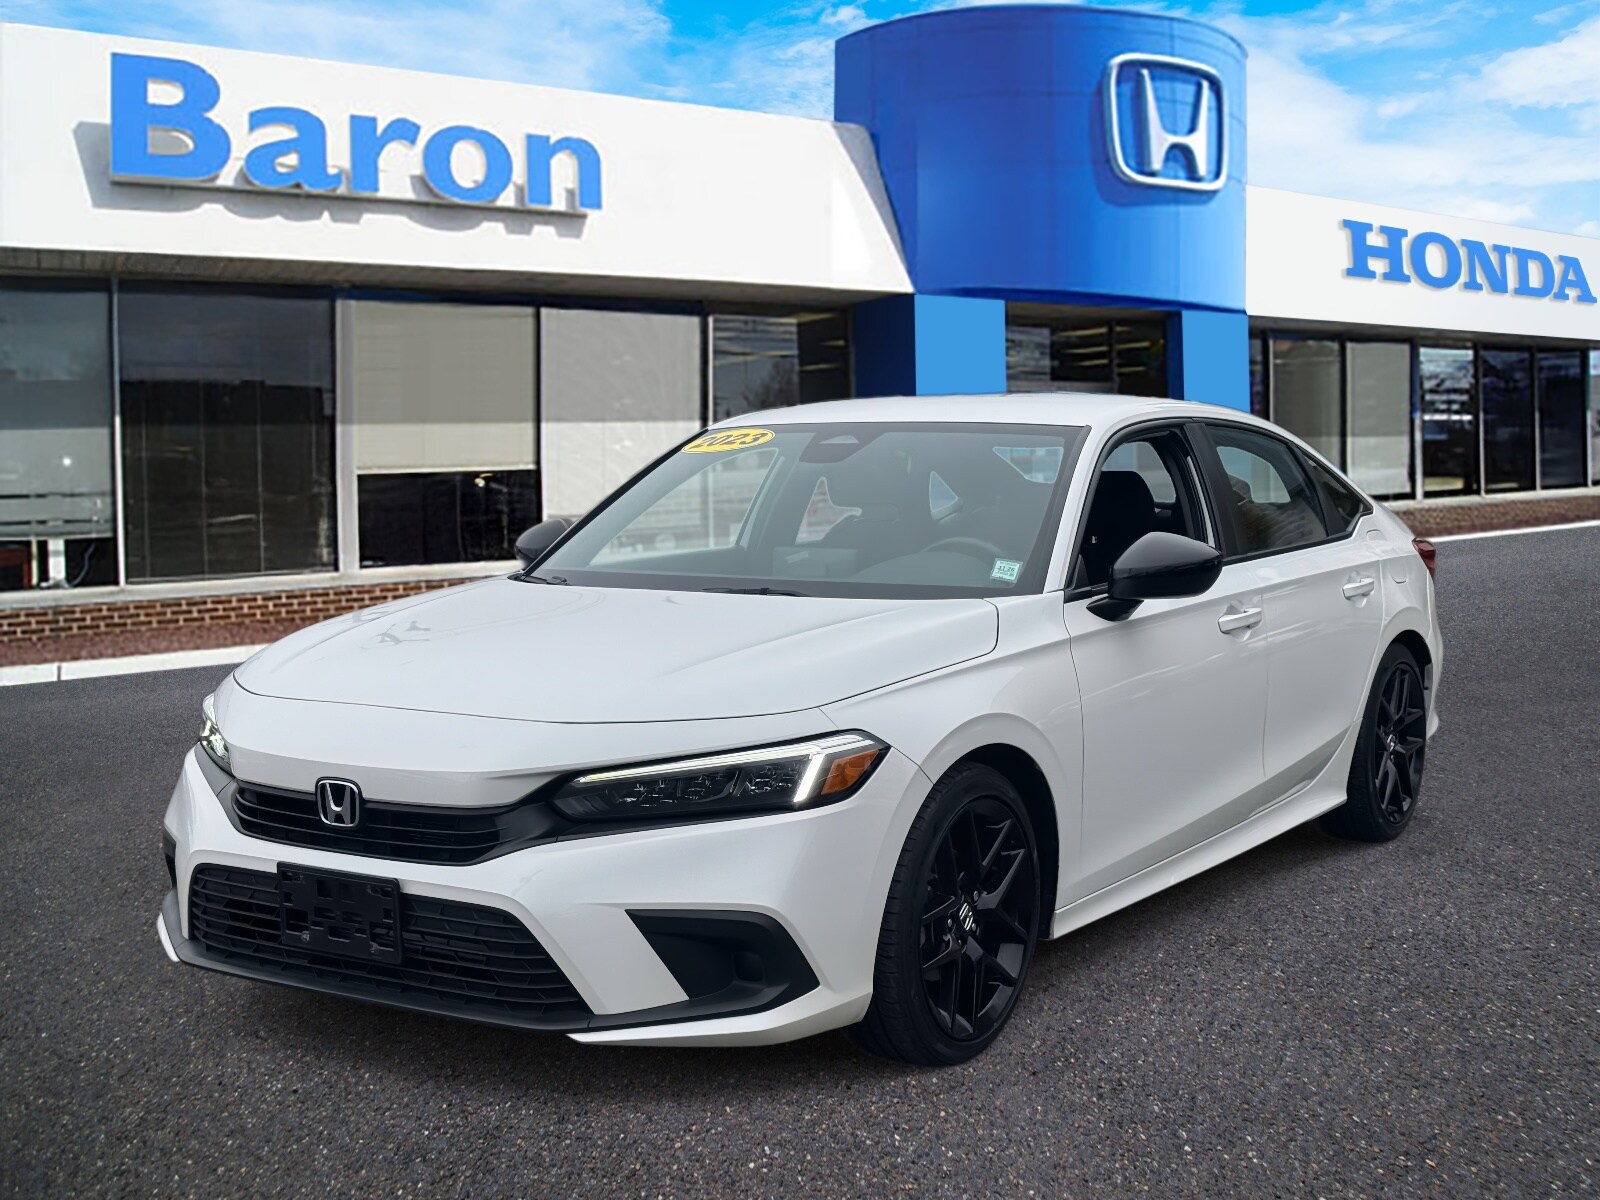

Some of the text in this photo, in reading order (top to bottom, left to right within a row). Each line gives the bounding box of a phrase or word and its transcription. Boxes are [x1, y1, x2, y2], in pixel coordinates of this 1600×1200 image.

[110, 52, 603, 210] Baron
[1342, 219, 1598, 304] HONDA
[687, 432, 769, 450] 2023
